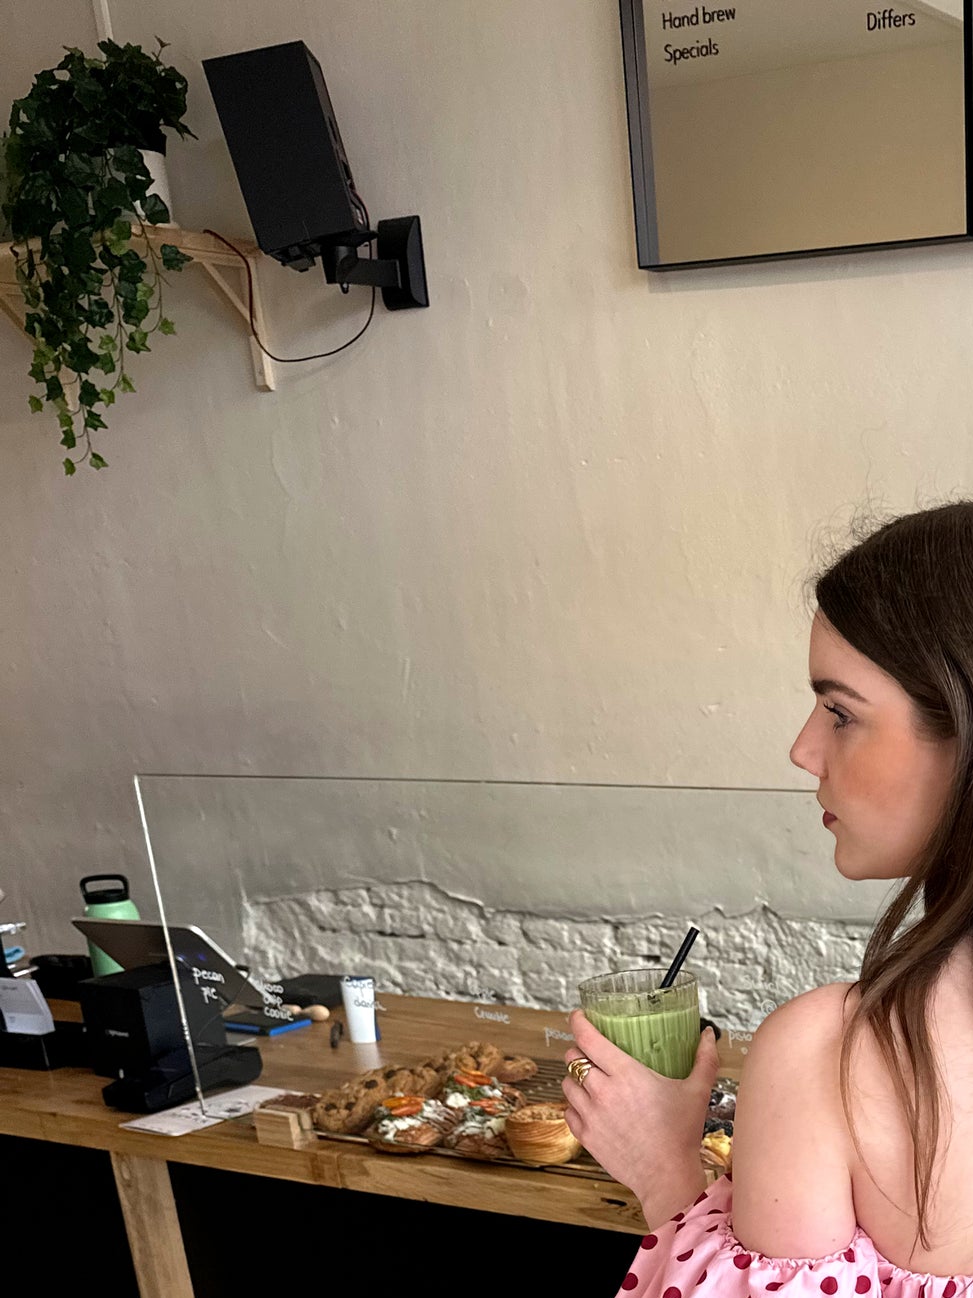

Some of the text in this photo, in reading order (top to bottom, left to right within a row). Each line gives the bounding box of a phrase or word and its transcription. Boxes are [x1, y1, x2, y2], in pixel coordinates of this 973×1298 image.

[662, 6, 736, 30] Hand brew
[866, 9, 916, 31] Differs
[664, 38, 719, 65] Specials
